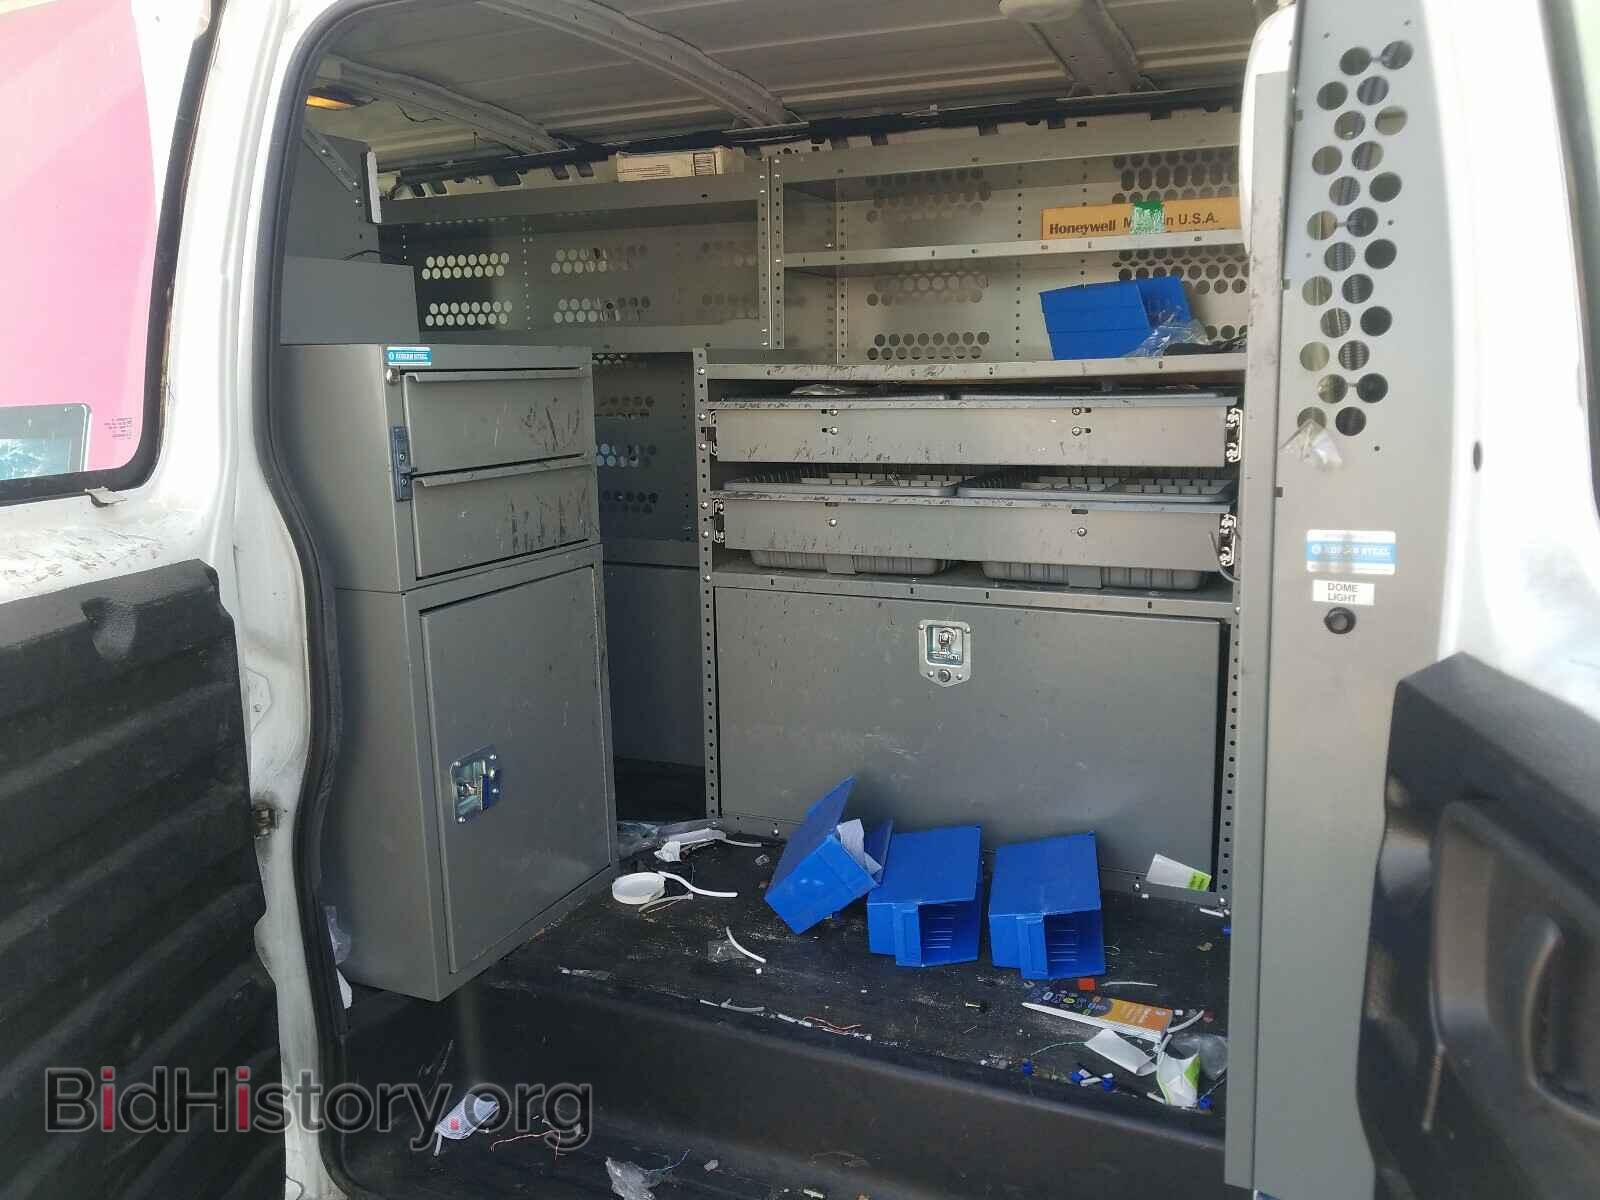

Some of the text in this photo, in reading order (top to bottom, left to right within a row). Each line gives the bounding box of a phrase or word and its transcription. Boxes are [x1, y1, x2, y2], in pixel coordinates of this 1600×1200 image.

[1049, 220, 1116, 235] Honeywell
[1178, 212, 1218, 225] U.S.A.
[1328, 583, 1359, 593] DOME
[1328, 592, 1357, 602] LIGHT
